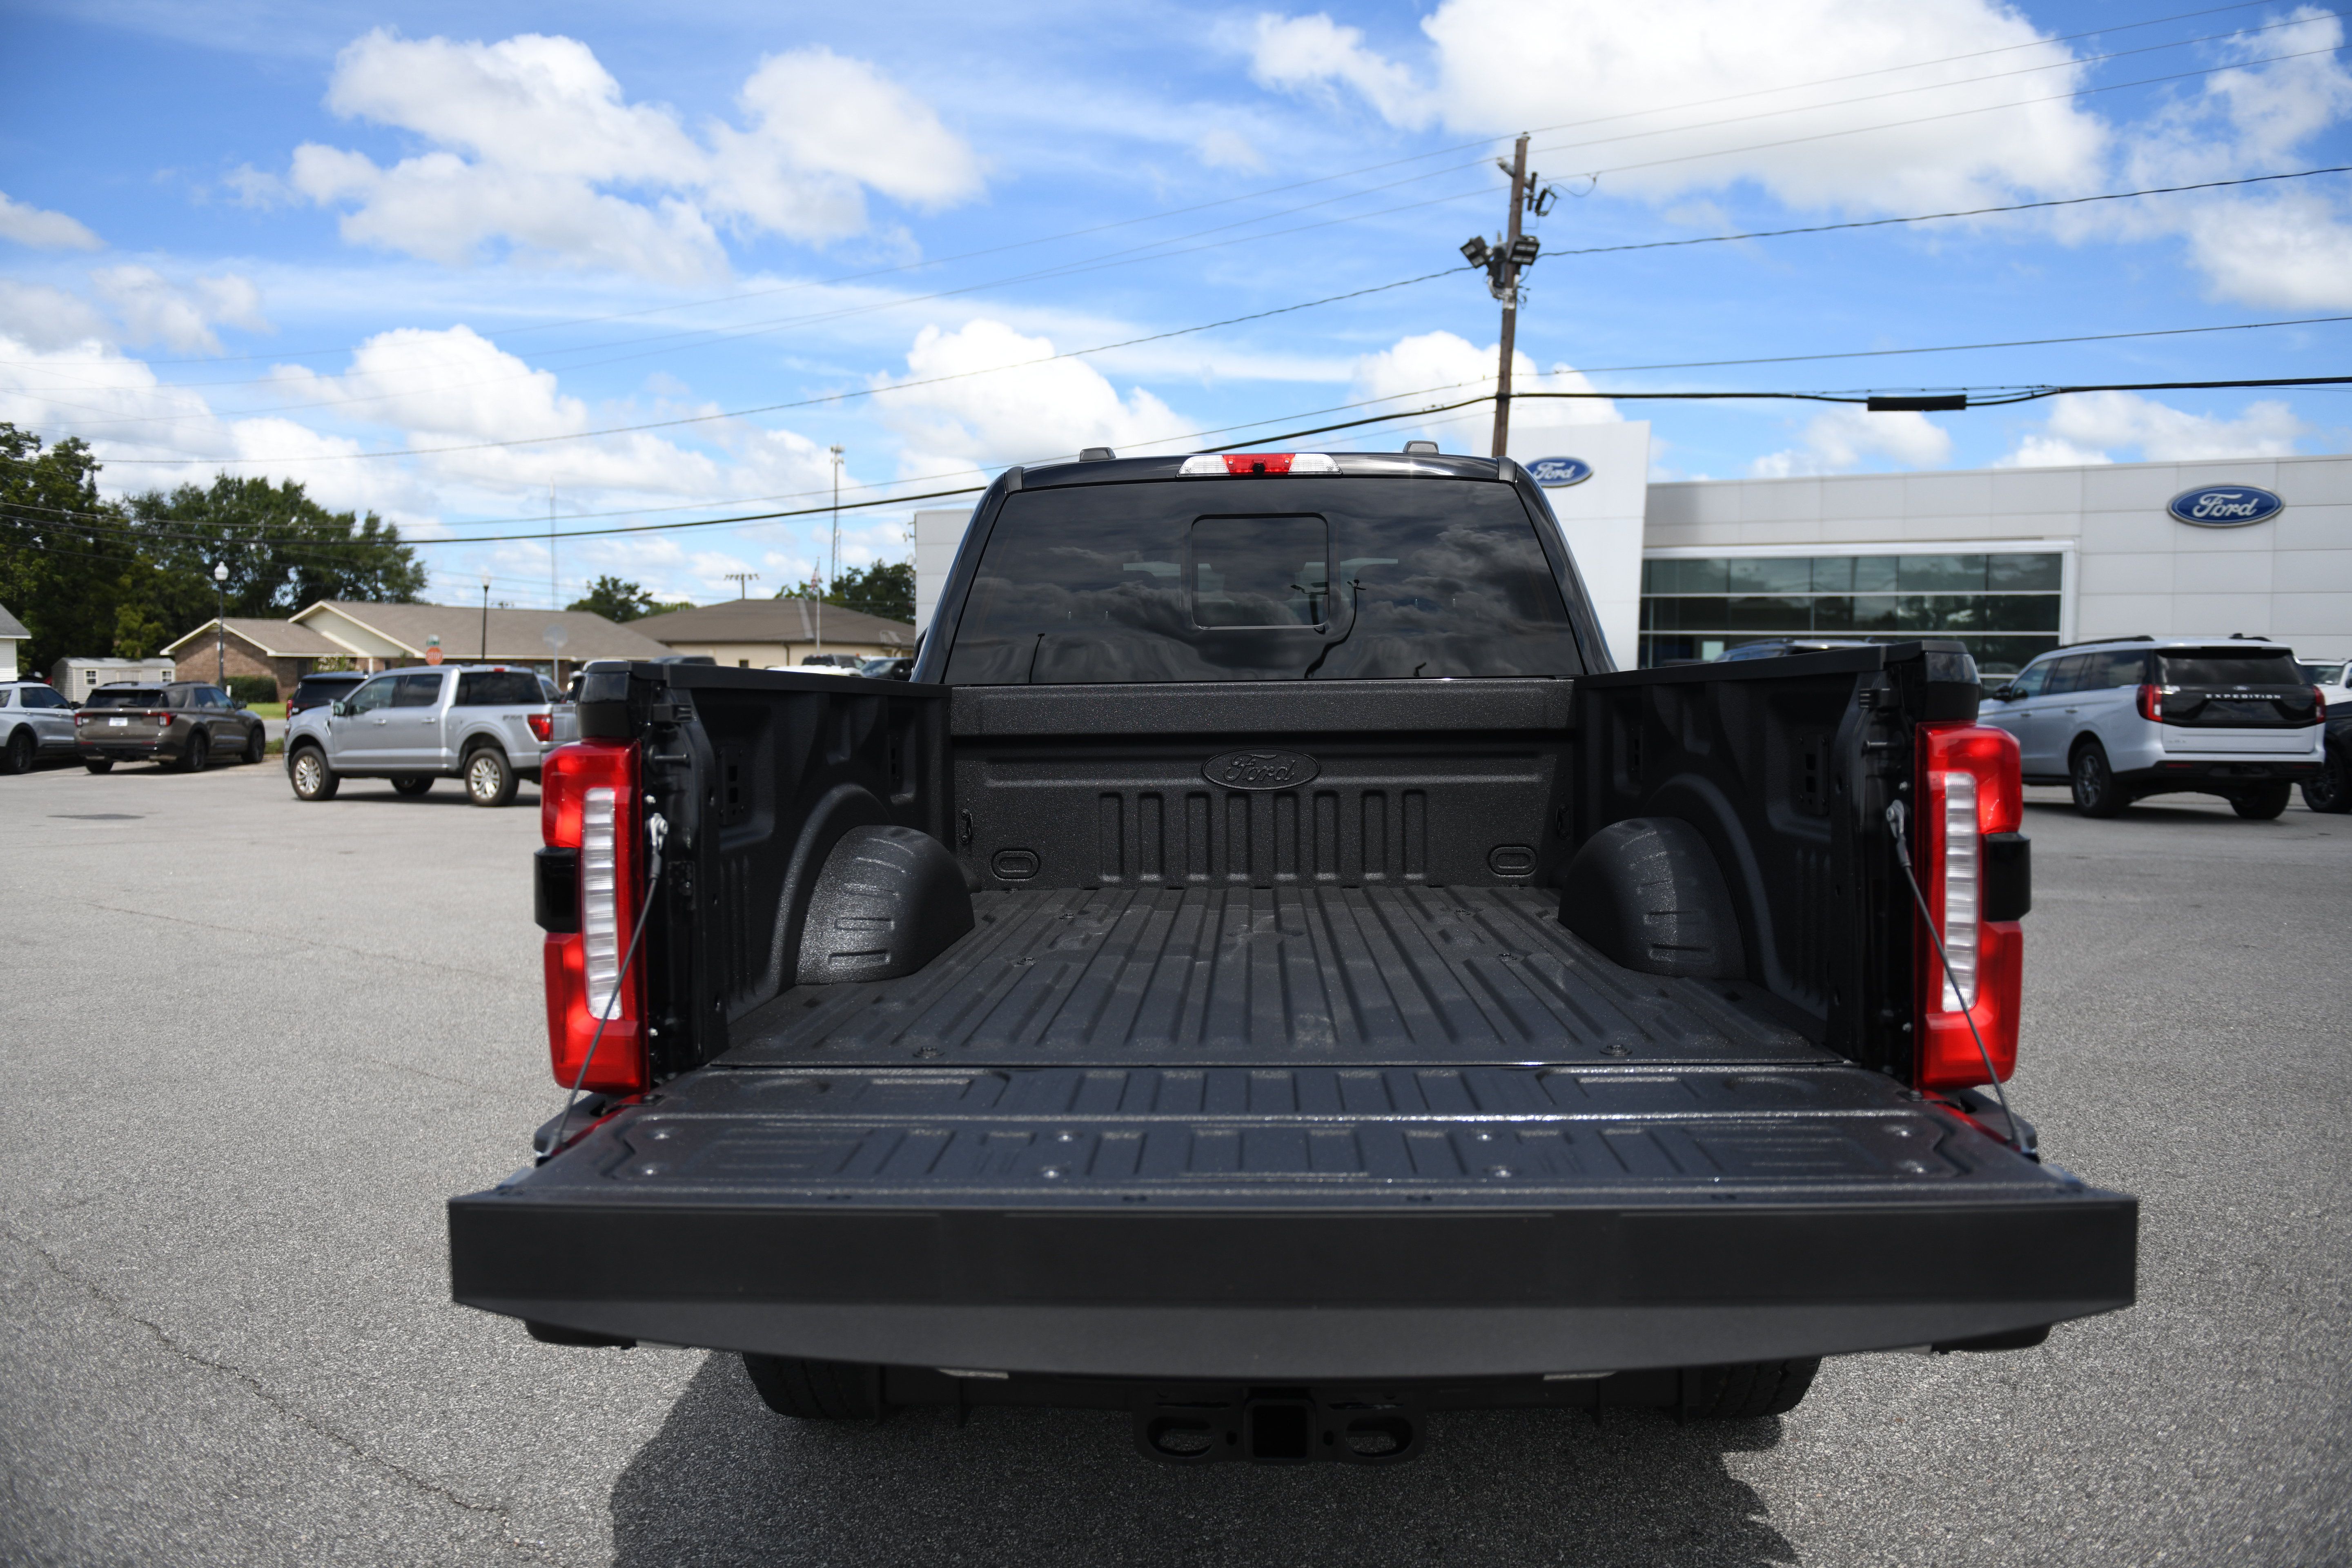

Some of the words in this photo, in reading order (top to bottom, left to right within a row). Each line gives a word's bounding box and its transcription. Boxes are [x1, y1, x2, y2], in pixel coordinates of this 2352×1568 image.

[1532, 462, 1576, 480] Ford
[2192, 492, 2259, 518] Ford
[1224, 753, 1296, 782] Ford
